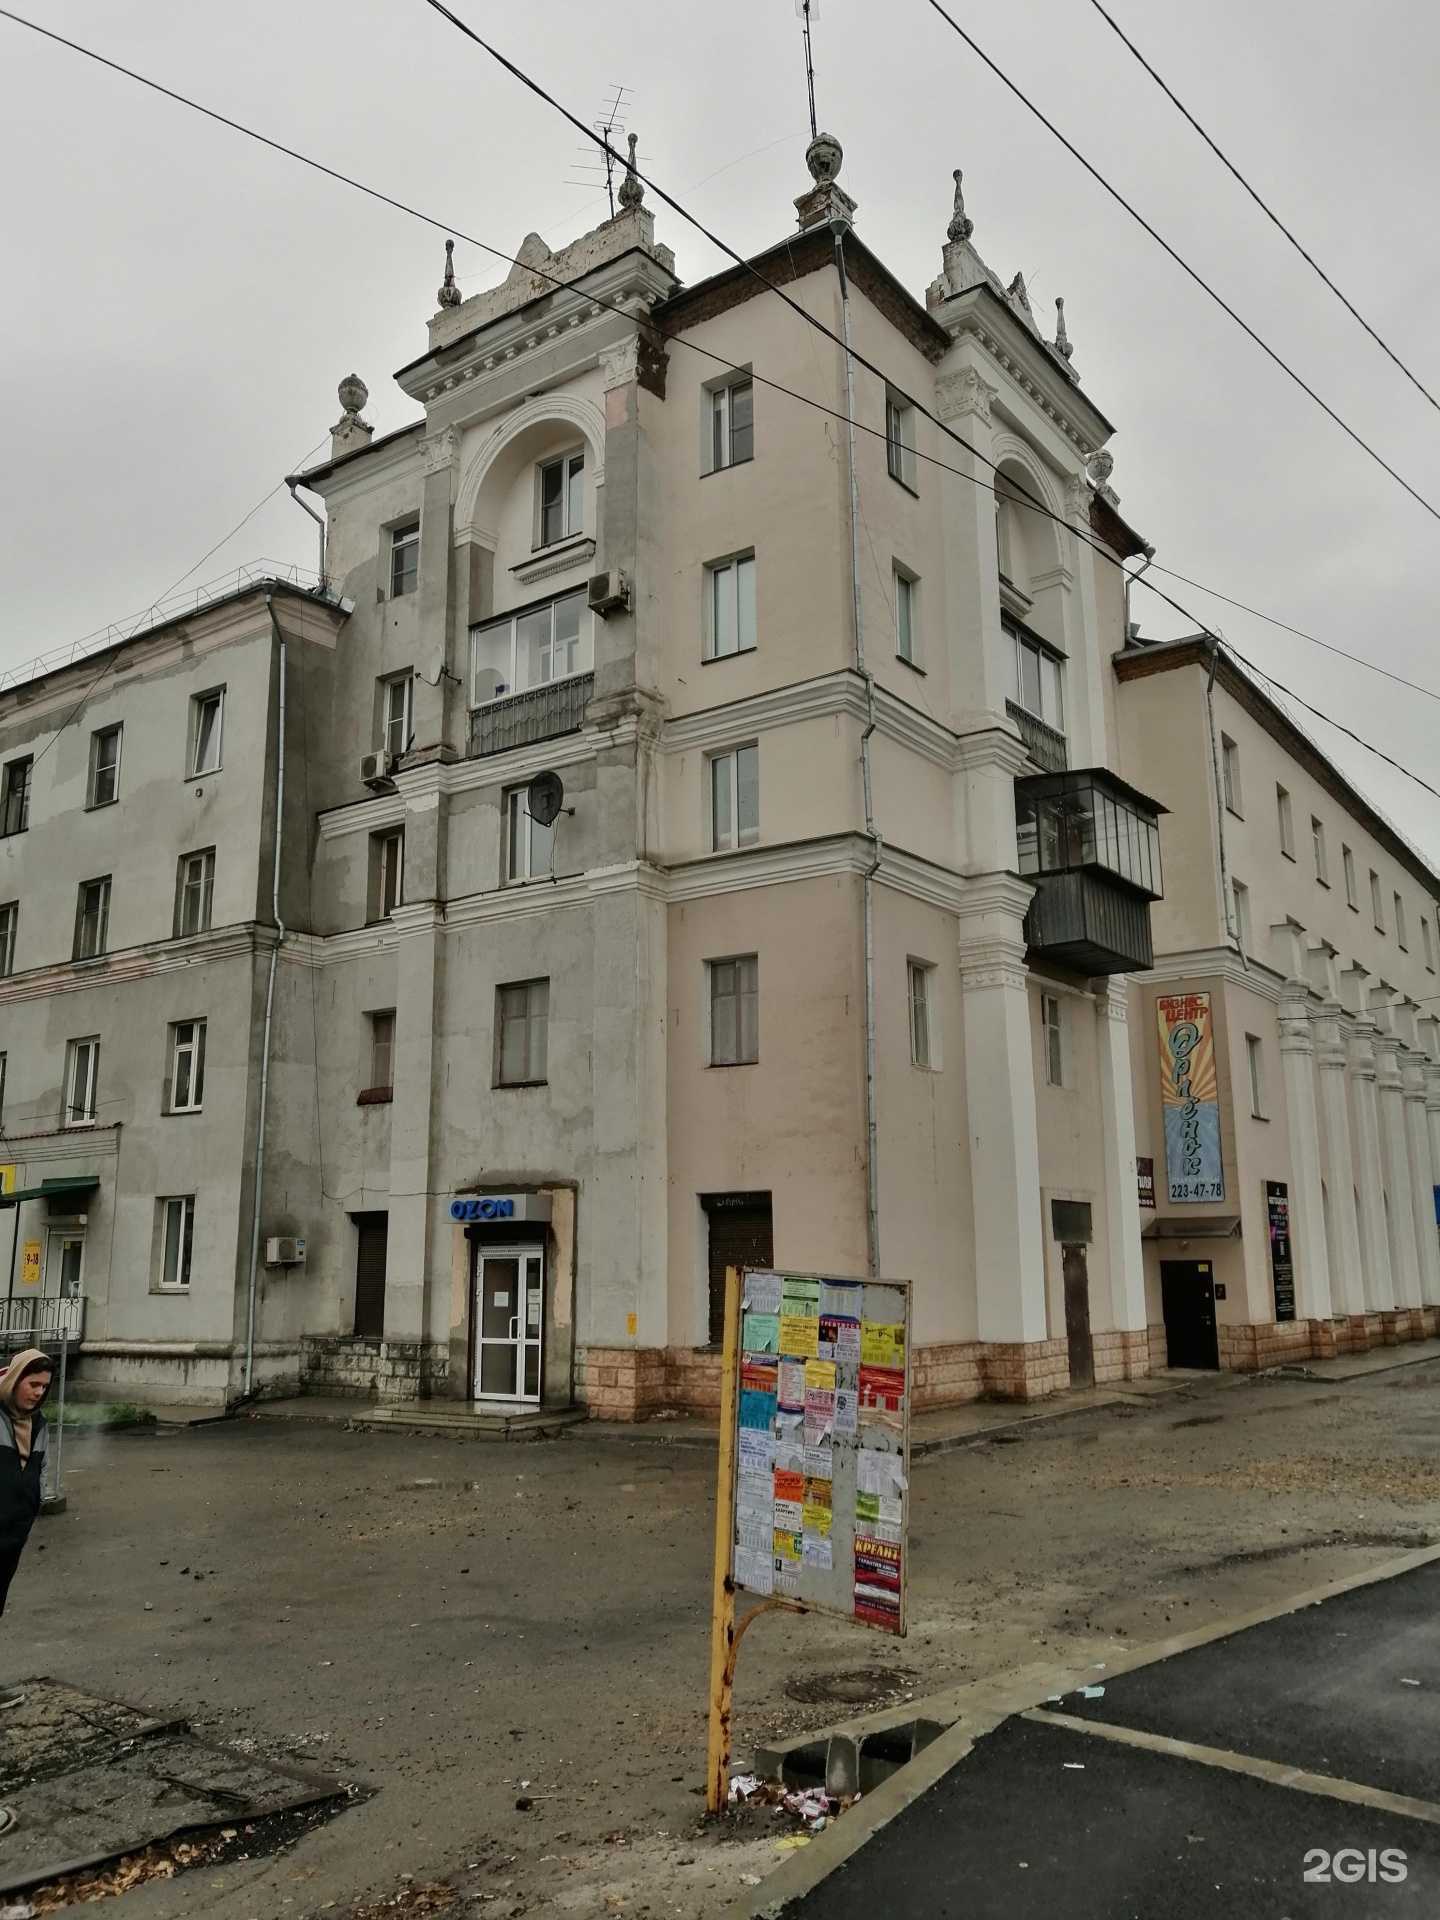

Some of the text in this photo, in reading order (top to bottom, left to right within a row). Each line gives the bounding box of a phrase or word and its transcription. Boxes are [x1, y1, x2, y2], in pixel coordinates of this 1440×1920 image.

[1159, 996, 1204, 1011] БИЗНЕС
[1166, 1007, 1209, 1023] ЦЕНТР
[1171, 1183, 1222, 1198] 223-47-78
[450, 1199, 514, 1220] OZON
